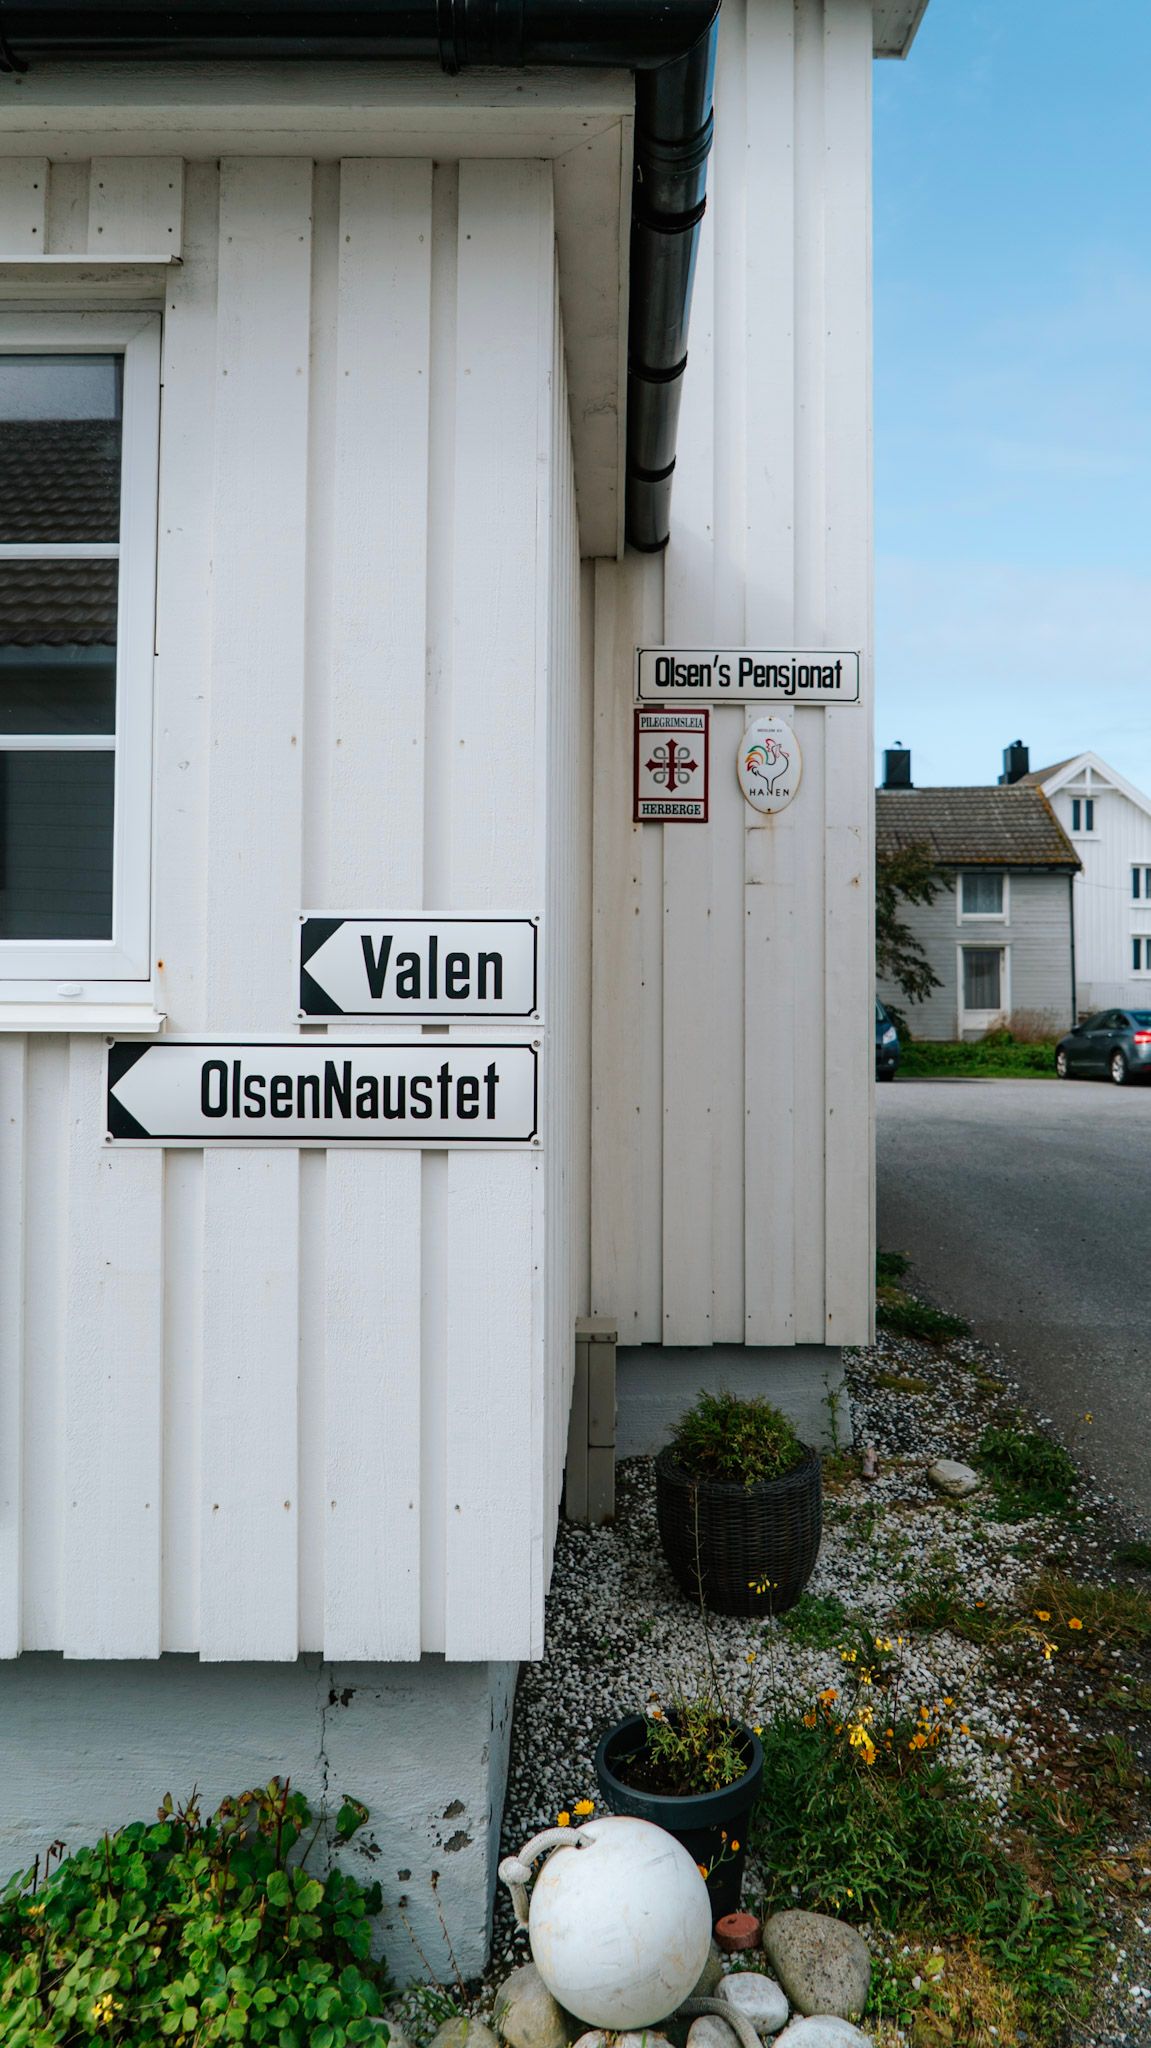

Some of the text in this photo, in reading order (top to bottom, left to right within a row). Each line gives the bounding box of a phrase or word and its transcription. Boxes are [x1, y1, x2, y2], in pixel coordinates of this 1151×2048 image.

[655, 655, 843, 696] Olsen's Pensjonat
[640, 716, 704, 729] PILEGRIMSLEIA
[749, 788, 790, 797] HANEN
[641, 803, 702, 816] HERBERGE
[360, 935, 504, 1000] Valen
[201, 1059, 500, 1120] OlsenNaustet
